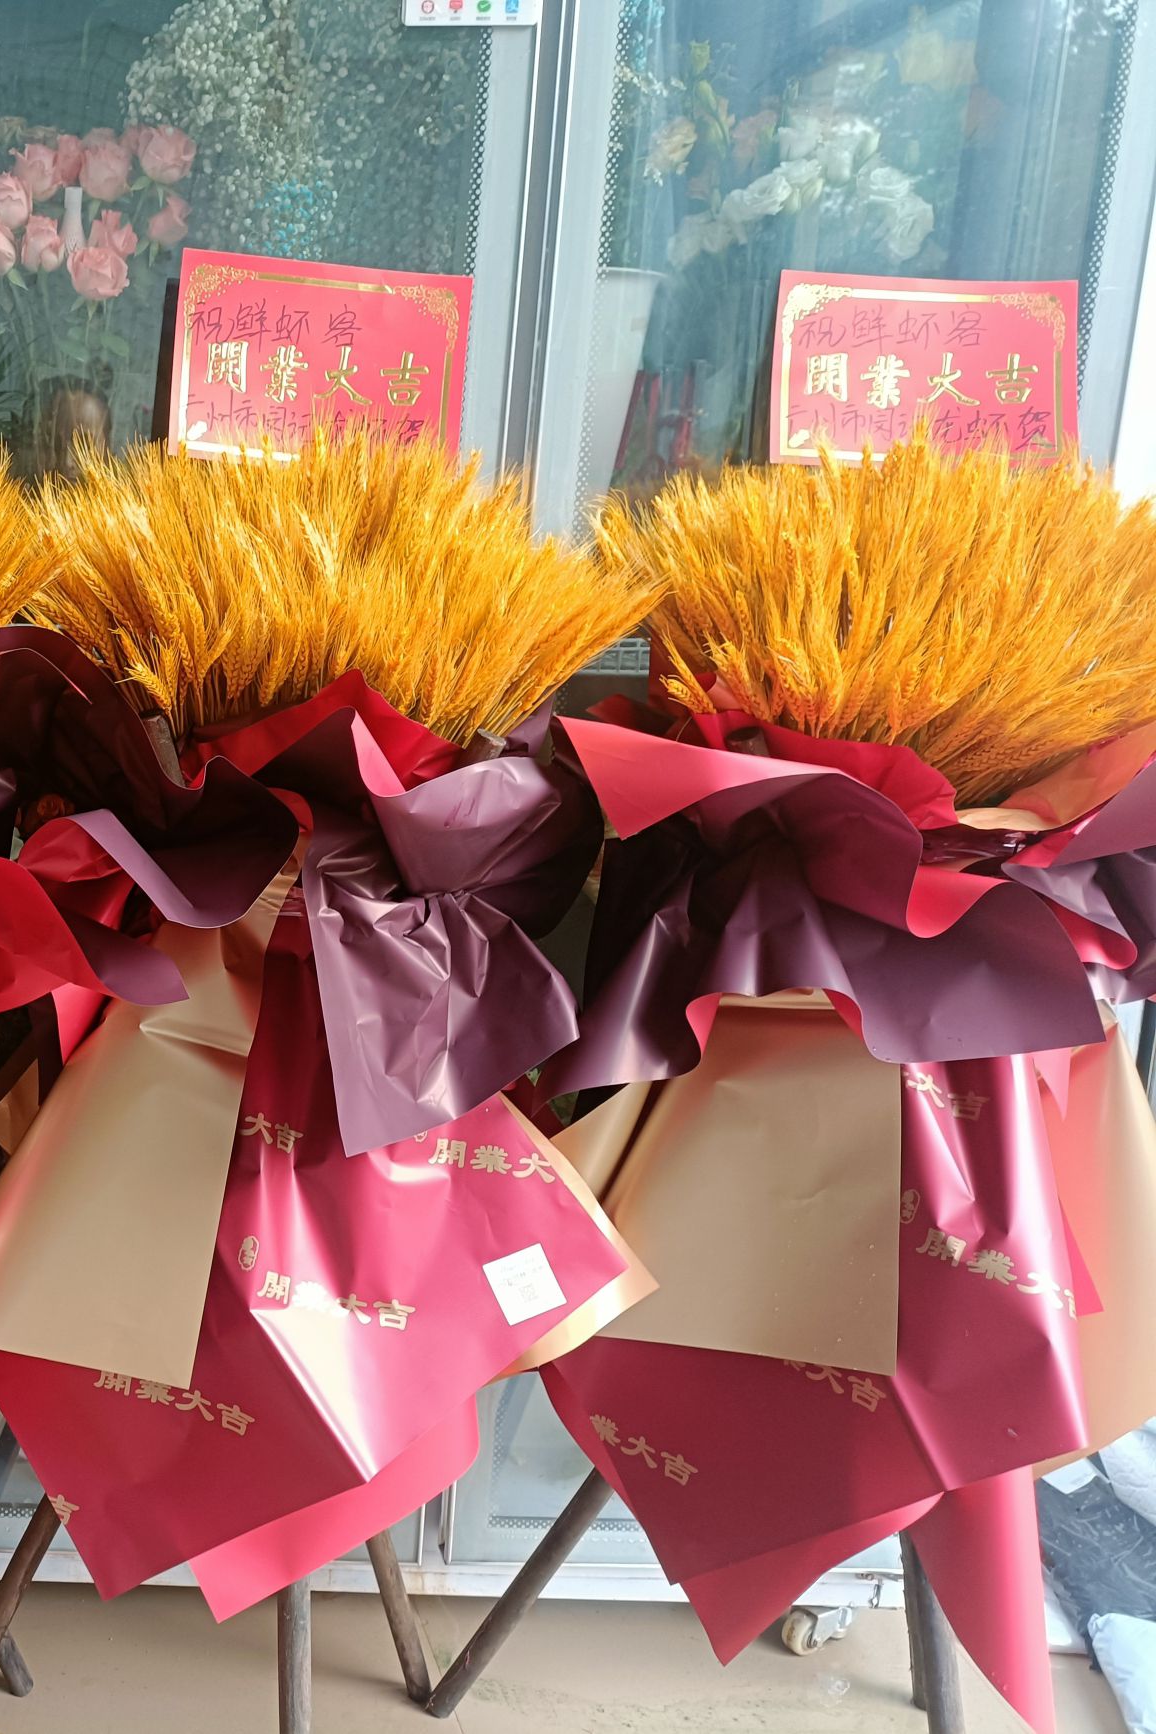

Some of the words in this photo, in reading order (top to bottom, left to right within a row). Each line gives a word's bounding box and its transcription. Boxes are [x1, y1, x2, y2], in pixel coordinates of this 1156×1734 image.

[204, 341, 429, 406] 開業大吉
[803, 352, 1039, 409] 開業大吉
[243, 1112, 304, 1154] 大吉
[428, 1137, 557, 1184] 開業大
[94, 1369, 255, 1436] 開業大吉
